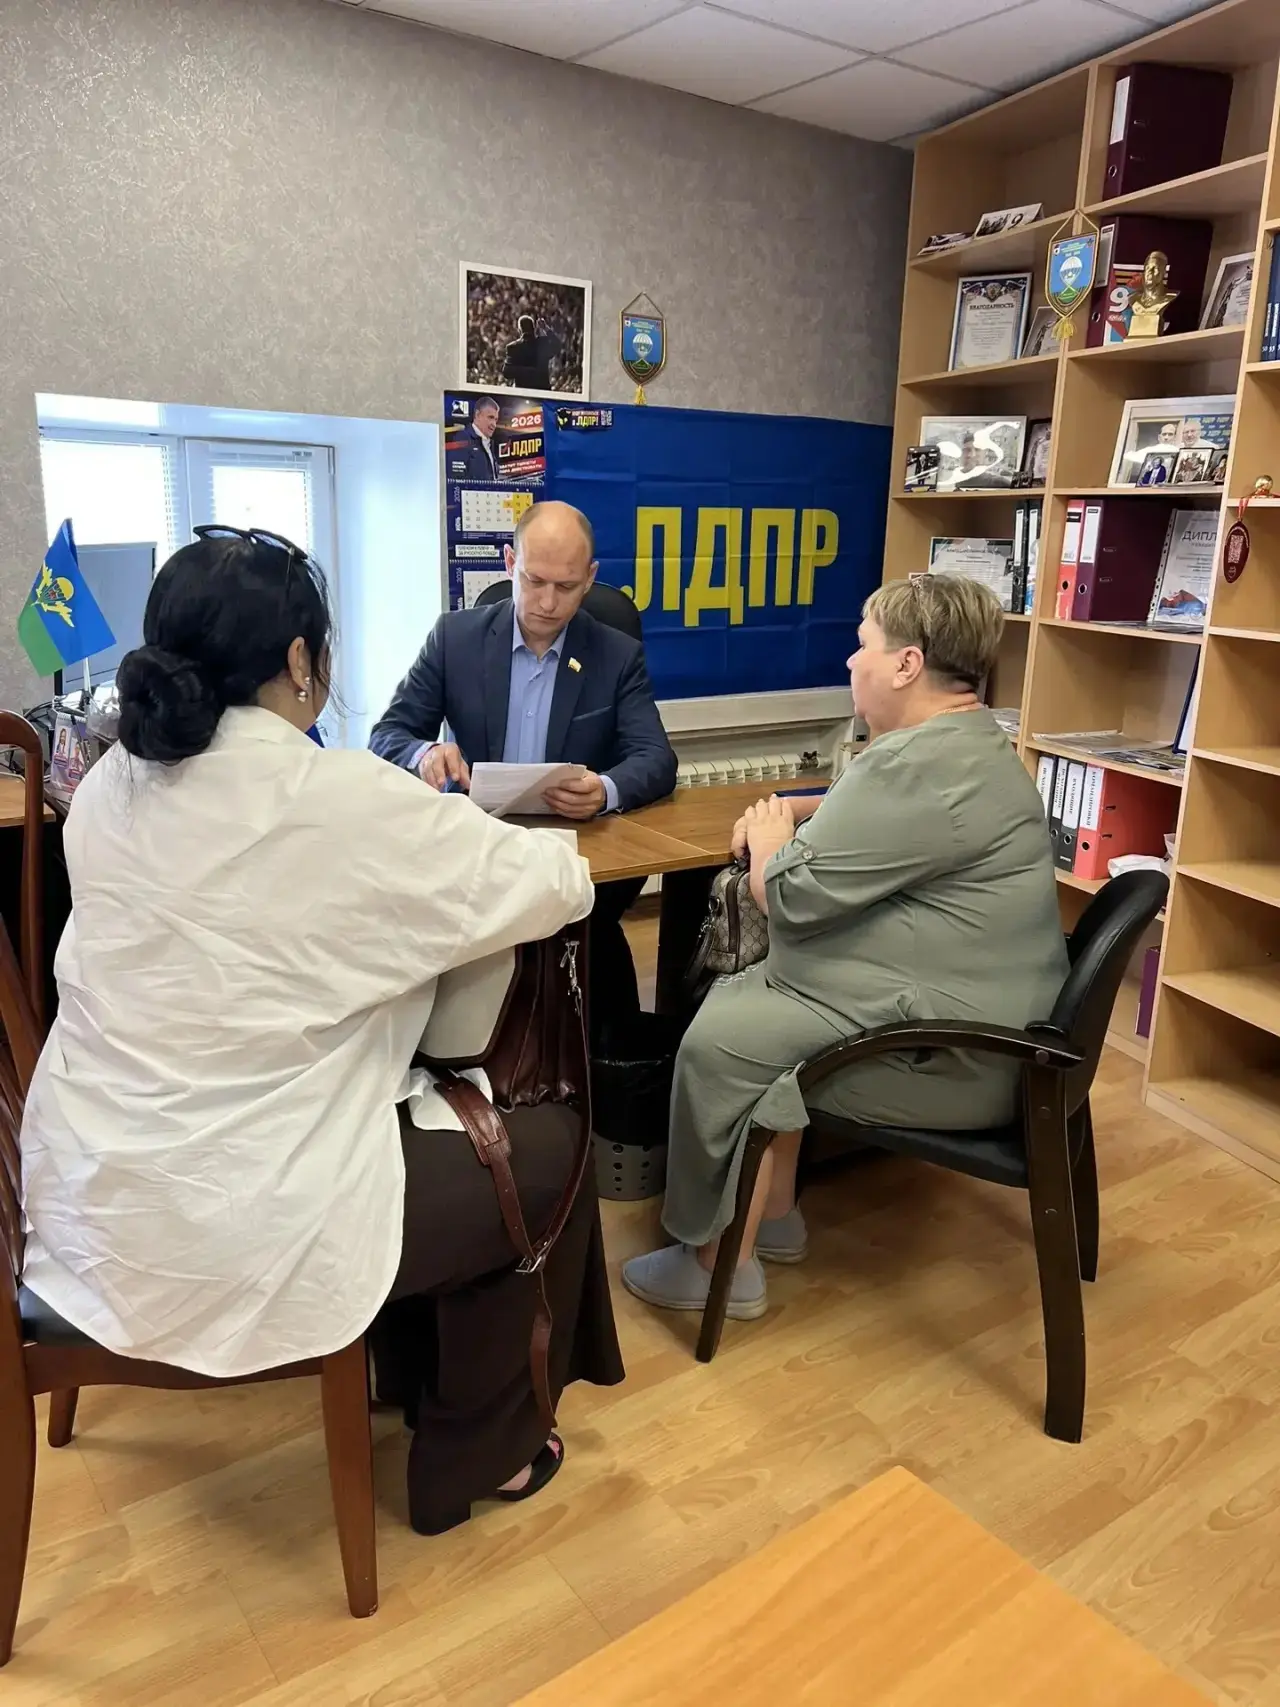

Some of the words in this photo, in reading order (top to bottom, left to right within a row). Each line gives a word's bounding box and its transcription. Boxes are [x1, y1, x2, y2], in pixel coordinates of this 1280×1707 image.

[511, 414, 542, 428] 2026
[511, 438, 542, 457] ЛДПР
[620, 506, 839, 627] ЛДПР
